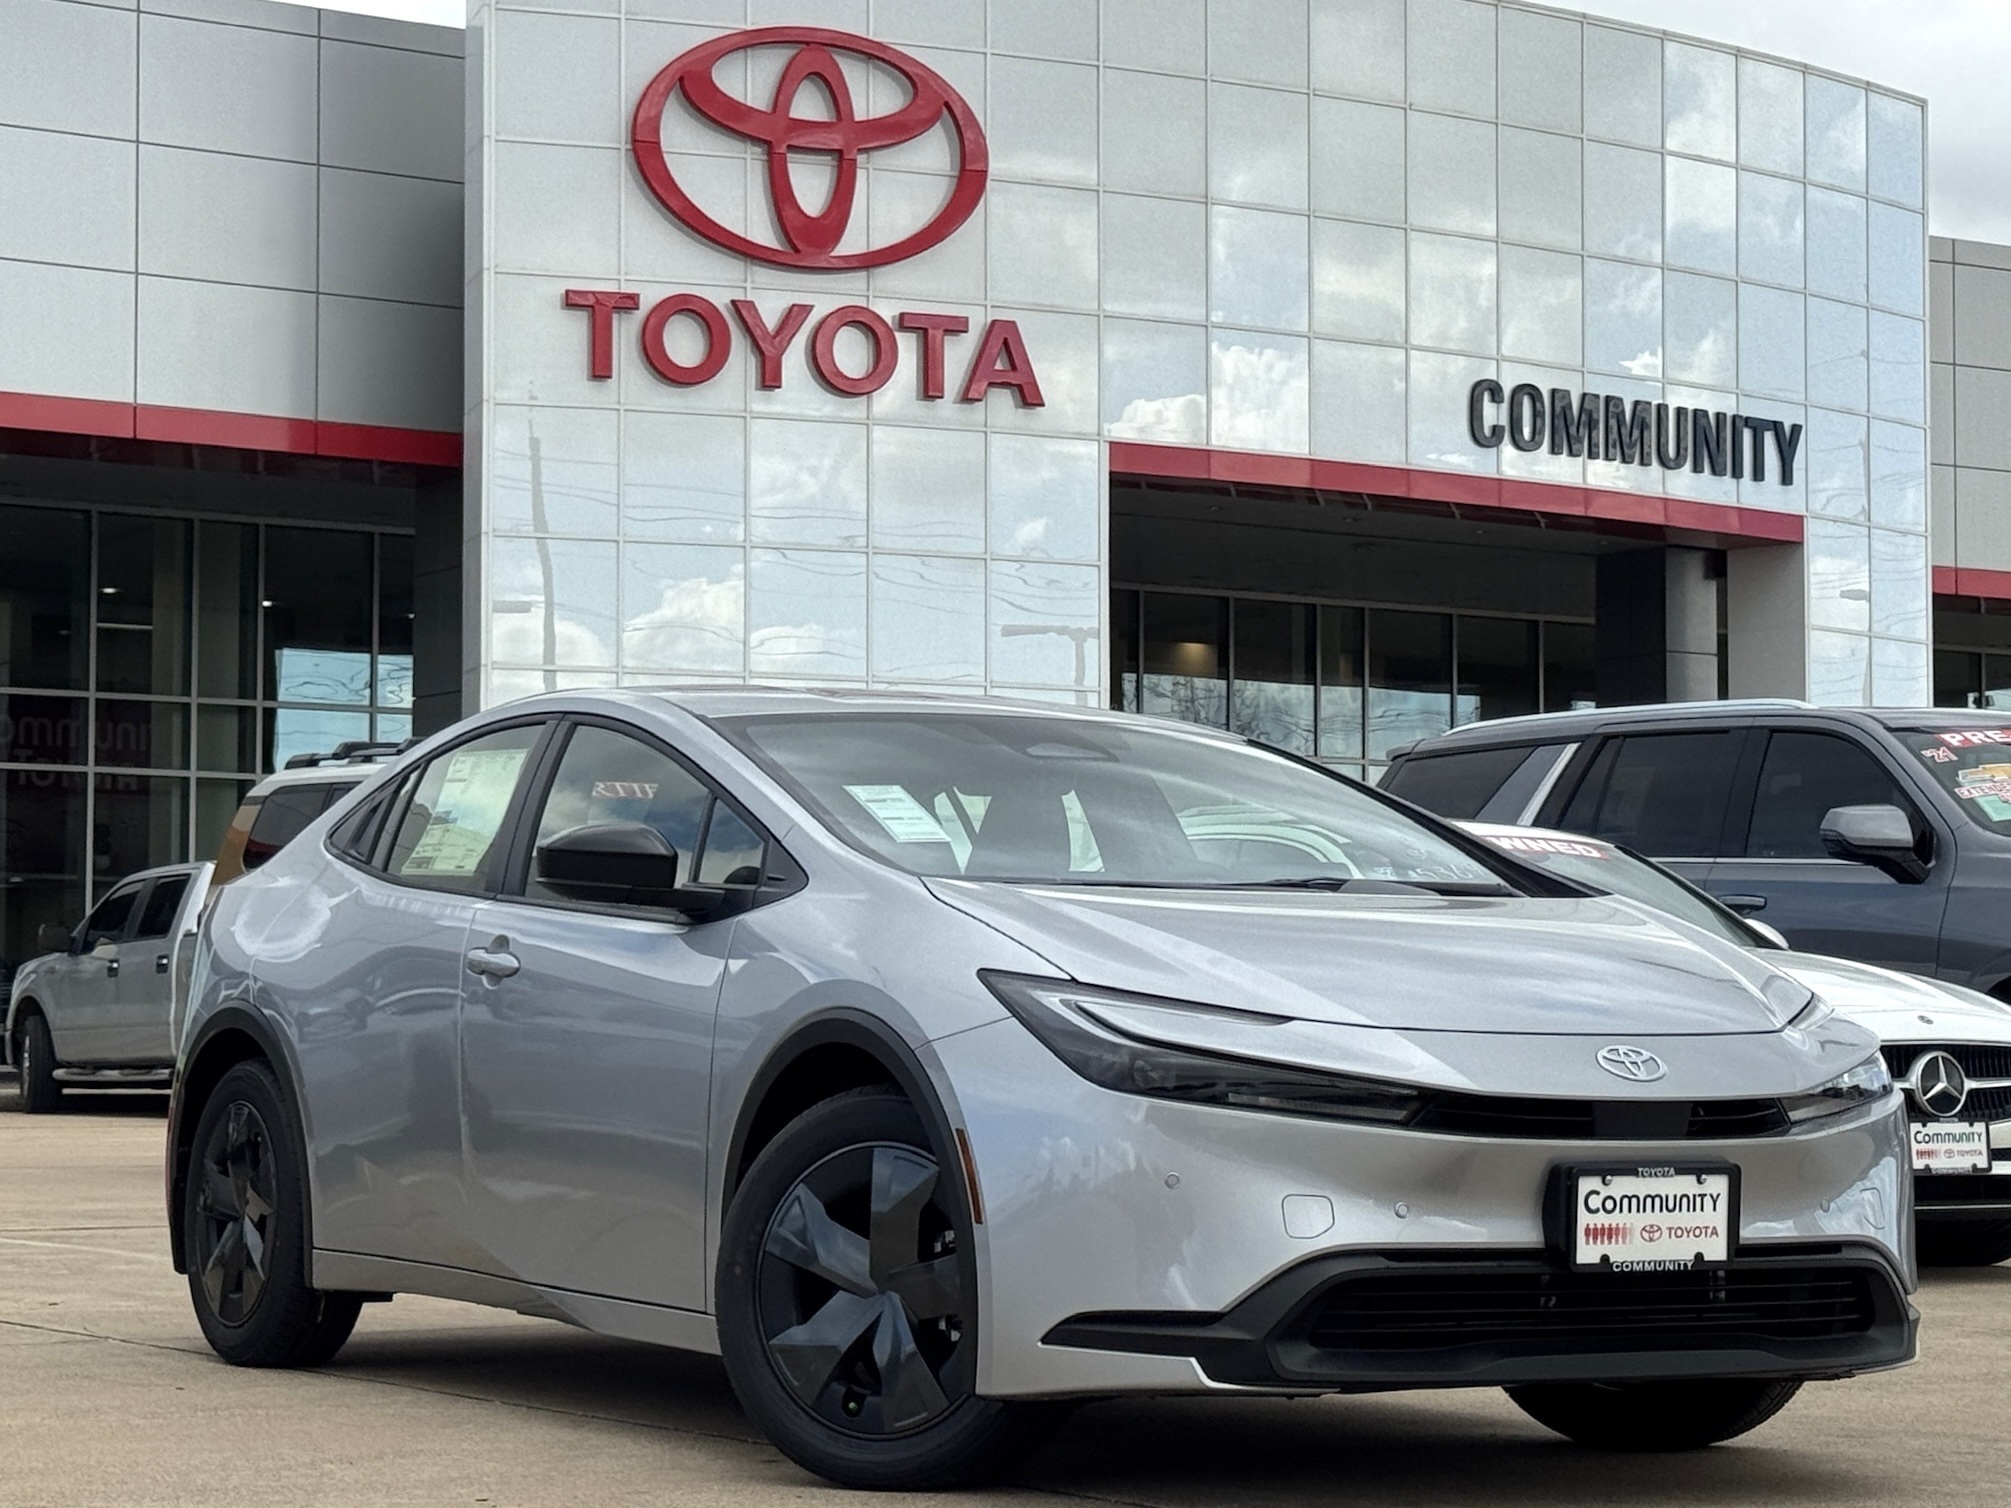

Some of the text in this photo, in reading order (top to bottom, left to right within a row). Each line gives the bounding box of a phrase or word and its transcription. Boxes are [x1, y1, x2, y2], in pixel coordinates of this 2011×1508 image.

[565, 289, 1046, 408] TOYOTA
[1468, 379, 1803, 486] COMMUNITY
[1637, 1167, 1676, 1177] TOYOTA
[1666, 1226, 1719, 1239] TOYOTA
[1612, 1260, 1695, 1272] COMMUNITY
